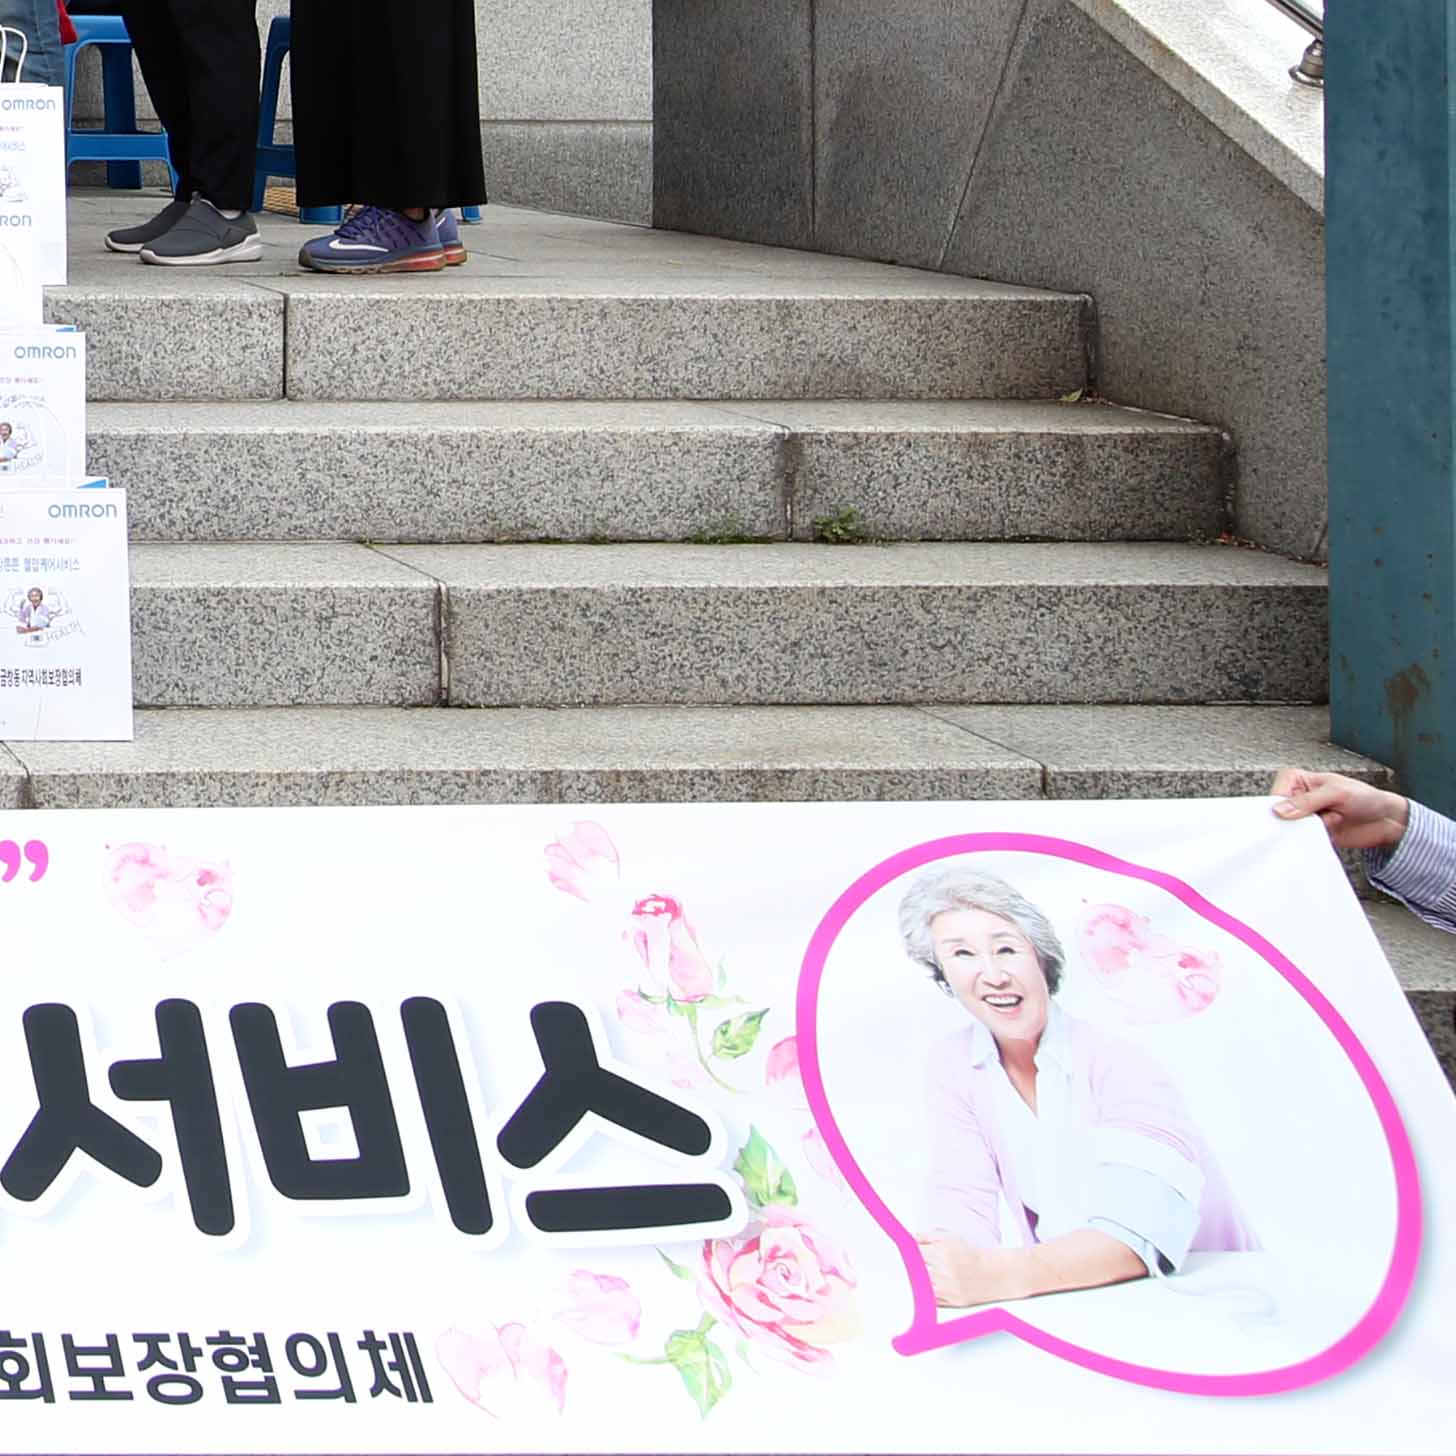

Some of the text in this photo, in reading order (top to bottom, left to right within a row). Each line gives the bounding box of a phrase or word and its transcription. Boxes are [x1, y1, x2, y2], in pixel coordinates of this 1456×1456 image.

[0, 97, 56, 112] OMRON
[13, 345, 77, 360] OMRON
[47, 503, 118, 519] OMRON
